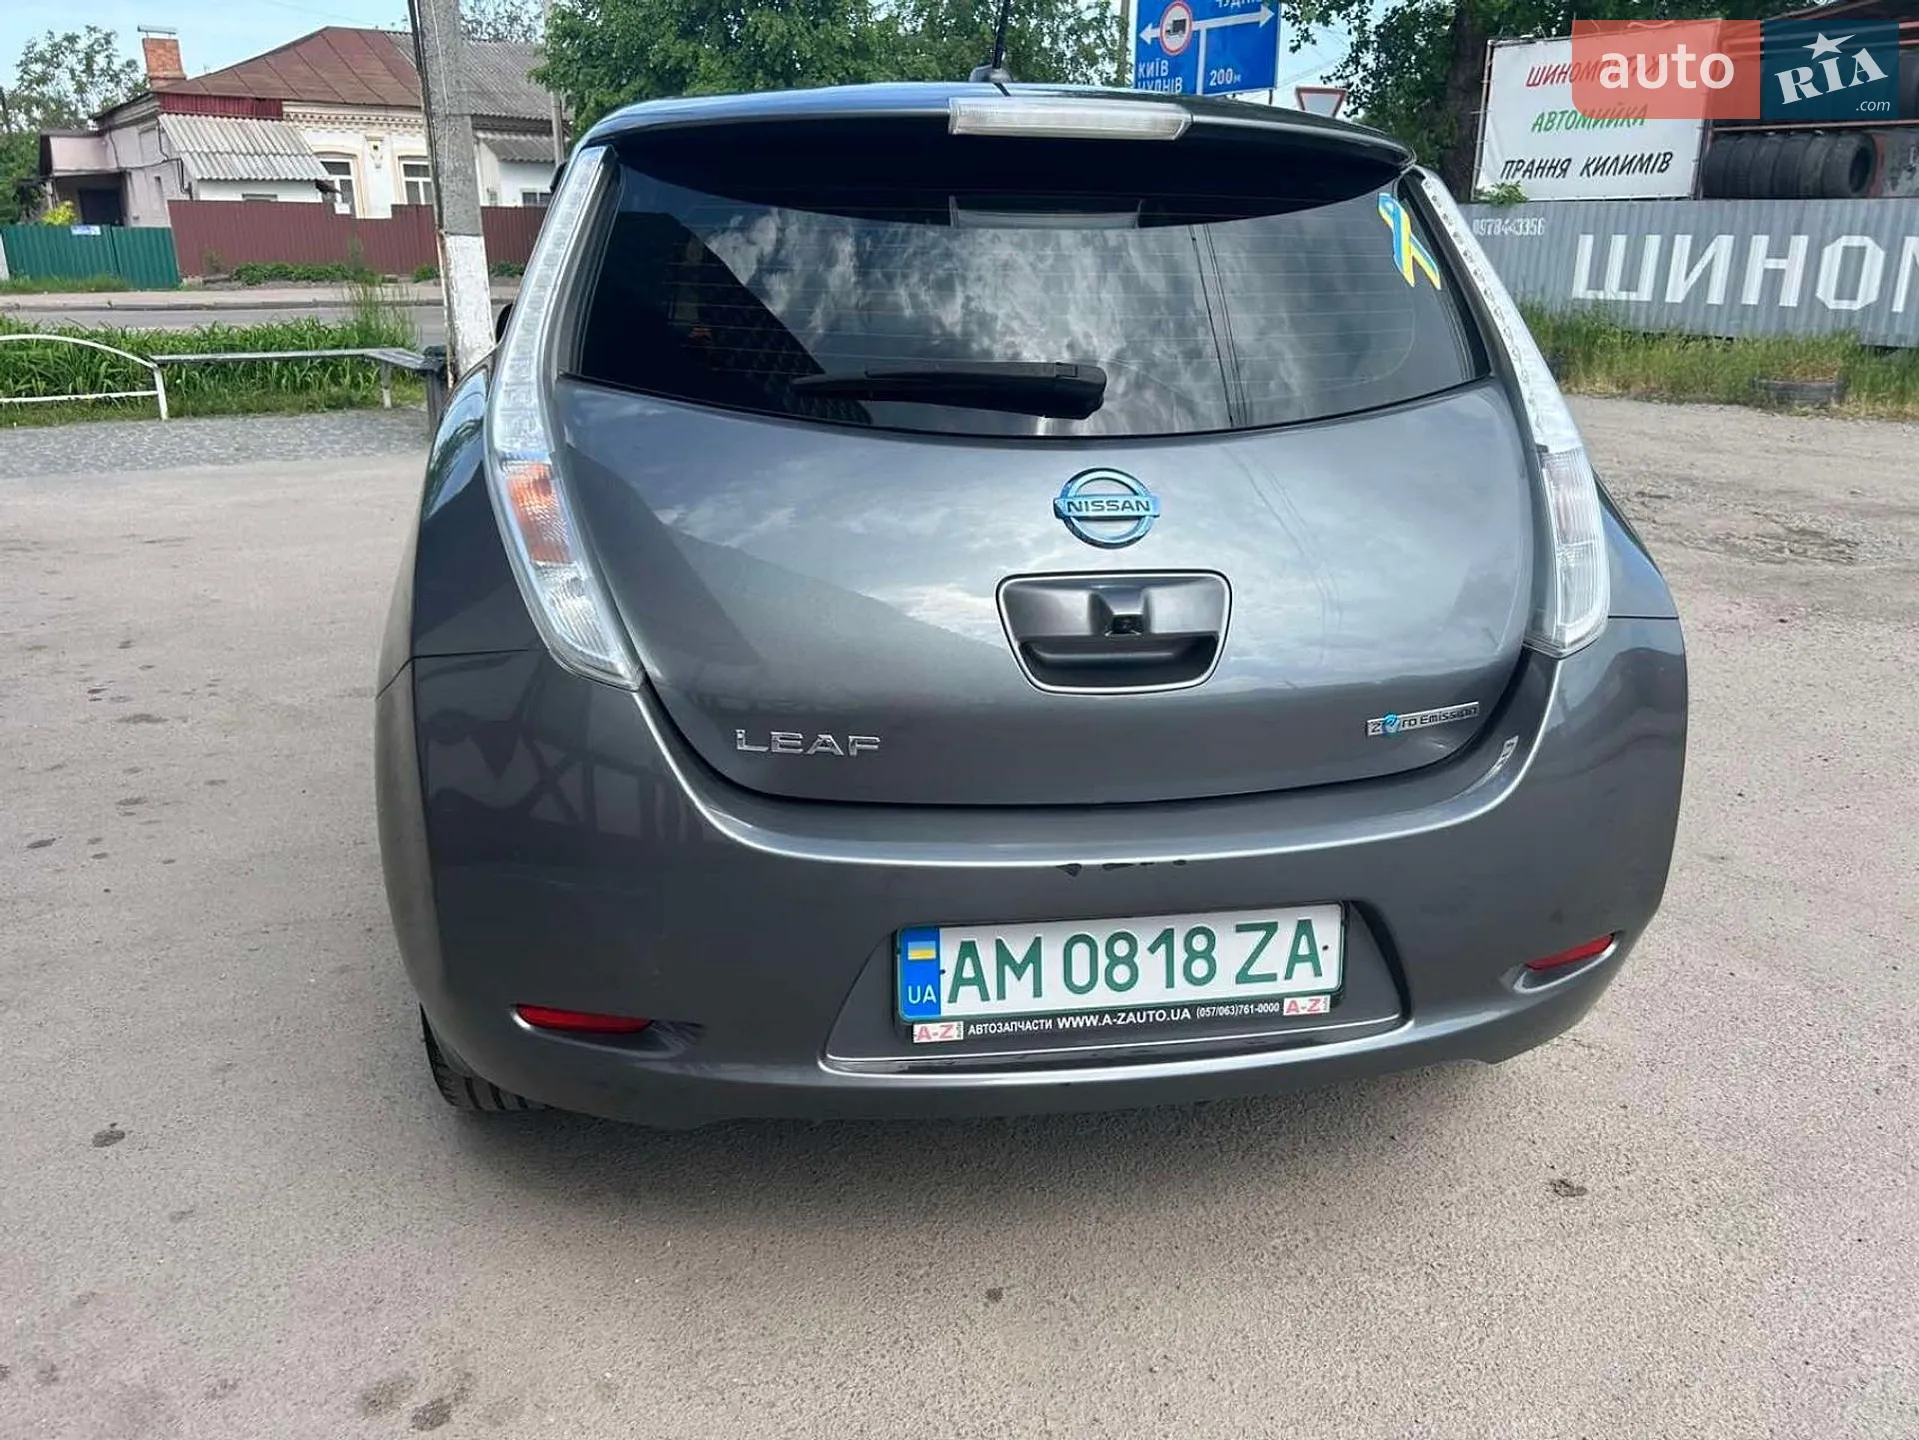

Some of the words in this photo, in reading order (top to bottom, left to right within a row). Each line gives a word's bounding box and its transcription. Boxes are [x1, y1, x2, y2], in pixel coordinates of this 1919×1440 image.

[1137, 58, 1169, 79] КИЇВ
[1525, 53, 1670, 88] ШИНОМТЖ
[1531, 102, 1649, 133] АВТОМИЙКА
[1499, 157, 1573, 181] ПРАННЯ
[1579, 151, 1674, 179] КИЛИМІВ
[1066, 499, 1151, 513] NISSAN
[735, 728, 881, 757] LEAF
[947, 935, 1043, 1004] AM
[1062, 924, 1218, 996] 0818
[1234, 918, 1323, 986] ZA
[907, 983, 937, 1005] UA
[914, 1022, 955, 1041] A-Z
[967, 1019, 1053, 1036] АВТОЗАПЧАСТИ
[1056, 1007, 1192, 1030] WWW.A-ZAUTO.UA
[1285, 997, 1322, 1015] A-Z
